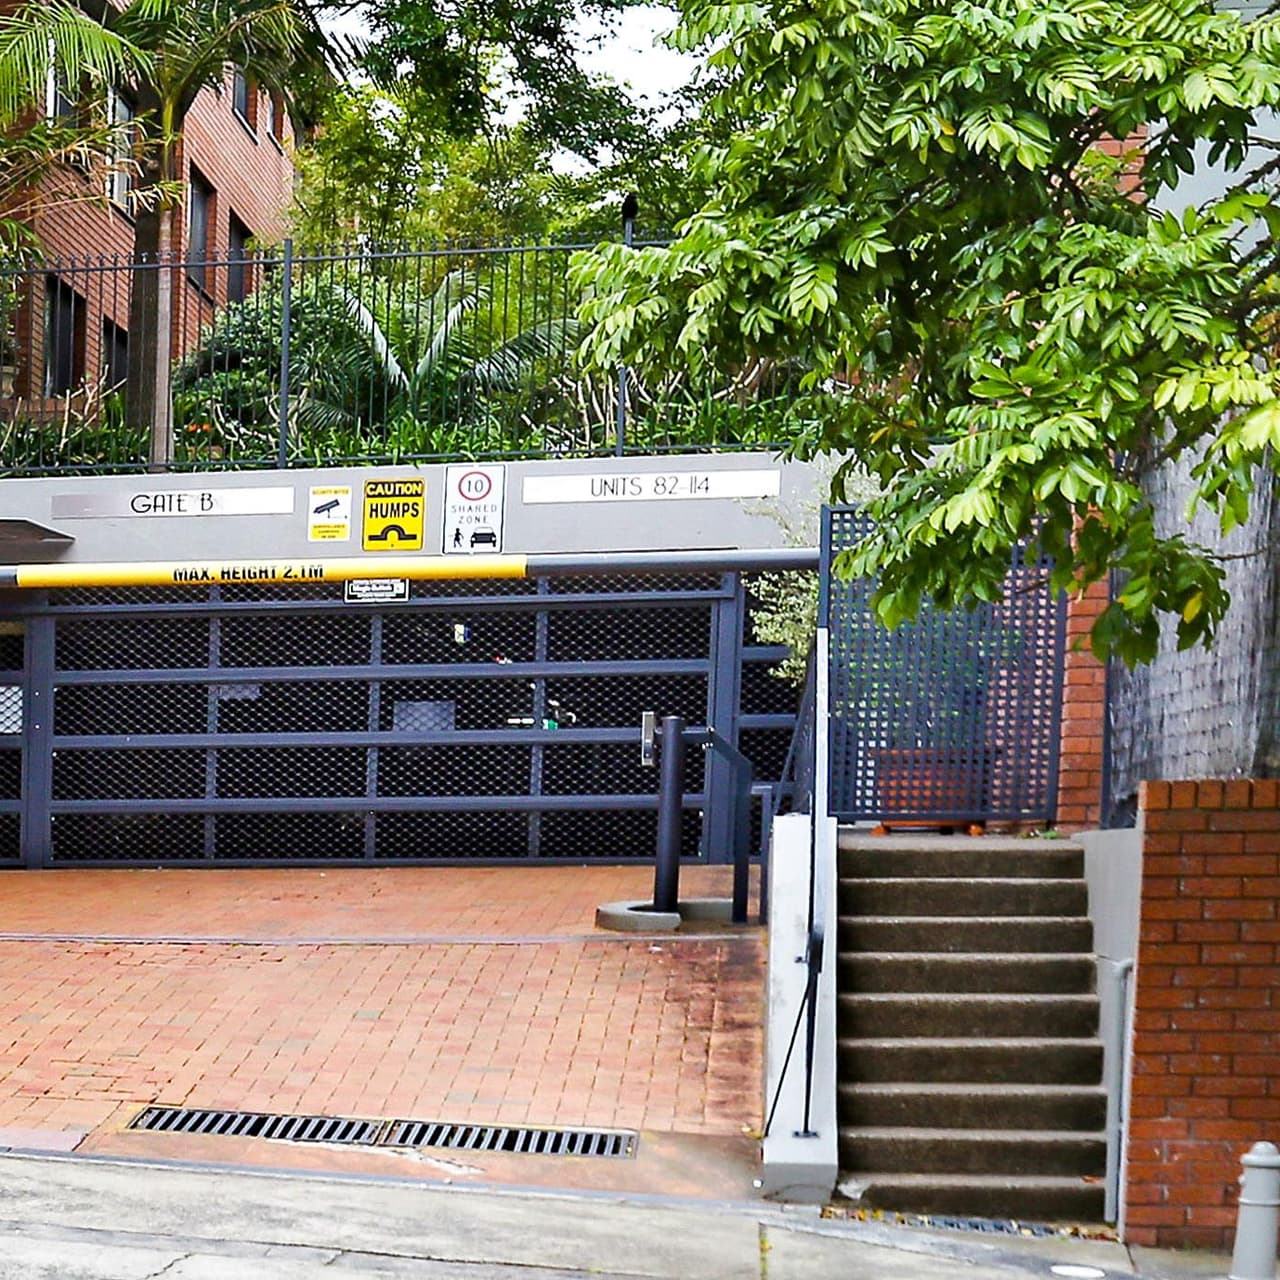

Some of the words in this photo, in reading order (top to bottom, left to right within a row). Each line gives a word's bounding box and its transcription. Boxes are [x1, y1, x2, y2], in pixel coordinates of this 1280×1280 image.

[366, 482, 423, 497] CAUTION
[466, 478, 485, 494] 10
[590, 476, 643, 497] UNITS
[653, 475, 710, 495] 82-114
[130, 493, 188, 514] GATE
[200, 492, 215, 512] B
[369, 502, 420, 519] HUMPS
[450, 504, 498, 514] SHARED
[458, 515, 489, 525] ZONE
[173, 567, 216, 581] MAX.
[220, 565, 278, 580] HEIGHT
[283, 564, 324, 579] 2.1M
